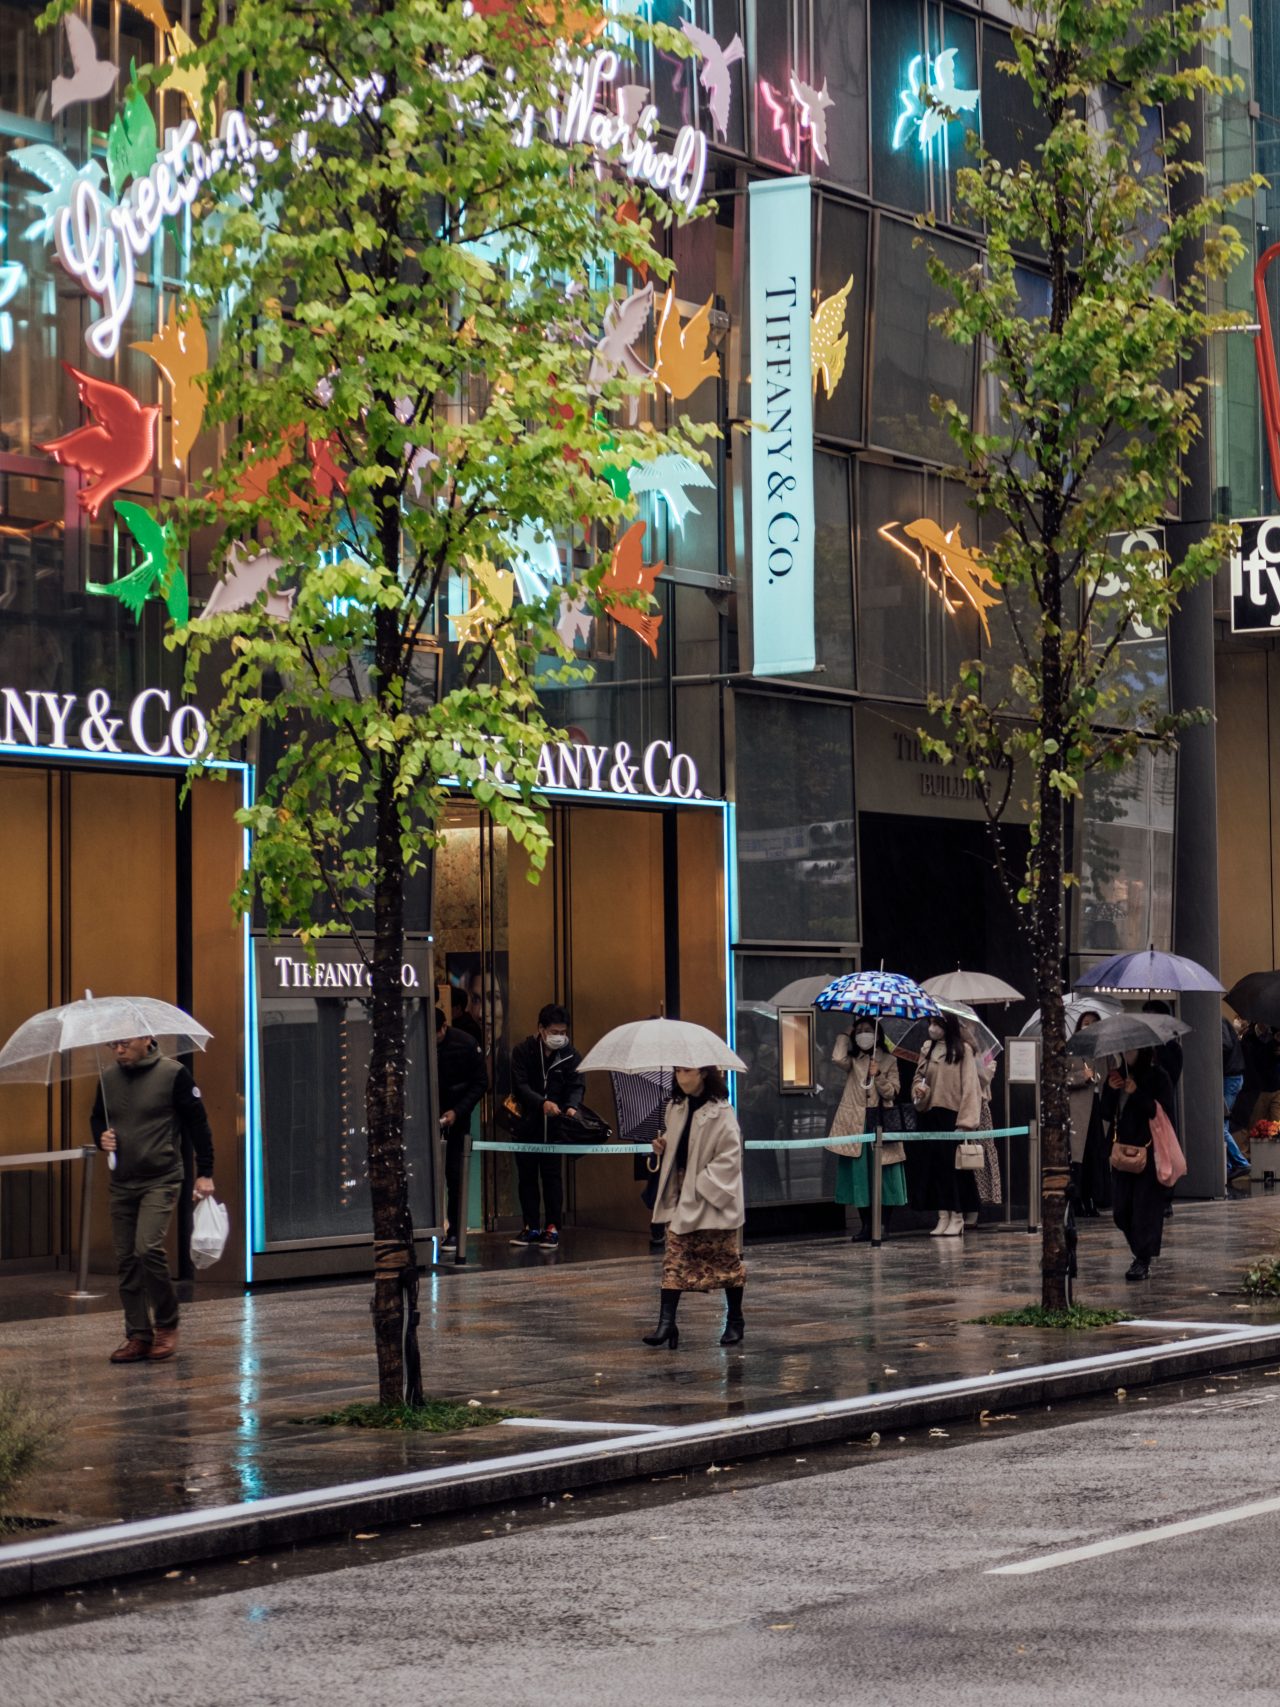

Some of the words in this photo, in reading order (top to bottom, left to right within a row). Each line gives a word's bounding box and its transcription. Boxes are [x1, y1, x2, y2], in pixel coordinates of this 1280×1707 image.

[765, 277, 799, 462] TIFFANY
[768, 471, 797, 503] &
[767, 511, 800, 585] CO.
[920, 773, 991, 799] BUILDI
